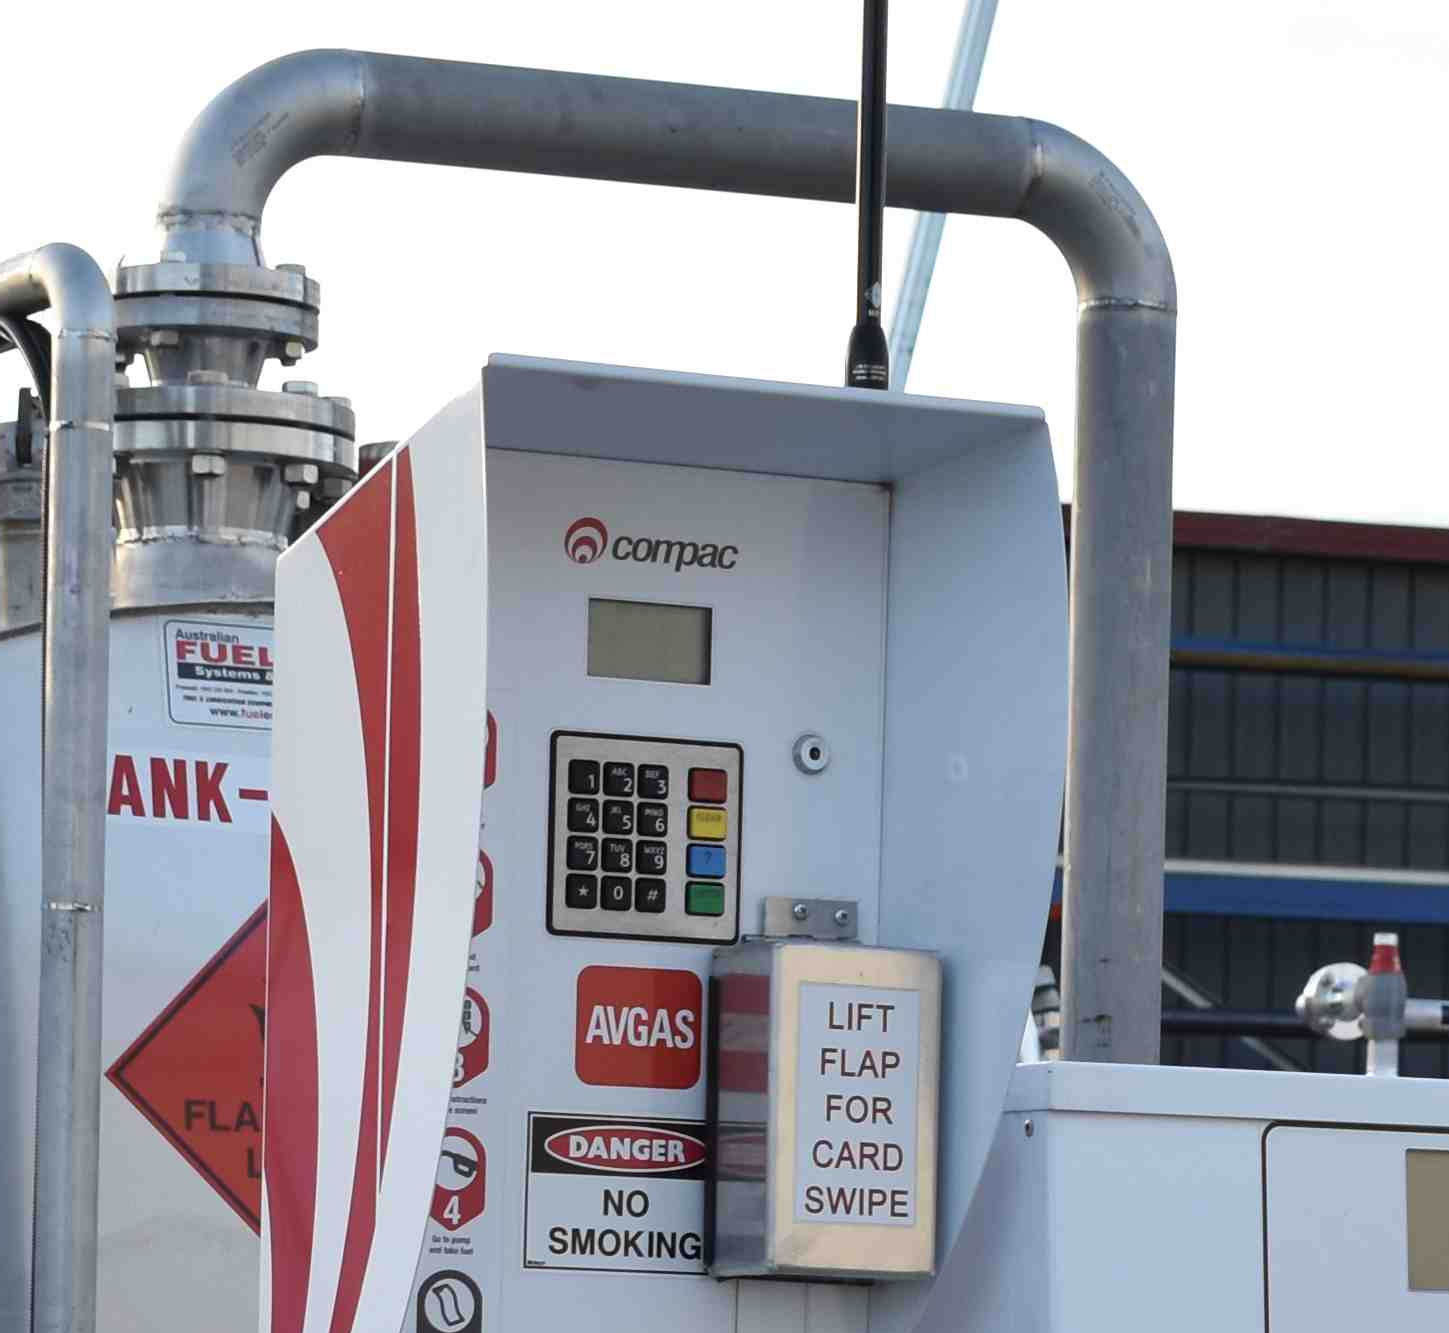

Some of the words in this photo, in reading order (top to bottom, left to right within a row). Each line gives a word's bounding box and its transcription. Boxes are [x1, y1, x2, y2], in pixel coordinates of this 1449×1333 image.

[611, 532, 738, 571] compac
[176, 628, 239, 643] Australian
[176, 640, 274, 666] FUEL
[195, 666, 261, 680] Systems
[108, 755, 268, 823] ANK-
[588, 774, 595, 789] 1
[623, 778, 633, 793] 2
[657, 780, 666, 794] 3
[586, 813, 596, 827] 4
[622, 815, 632, 830] 5
[655, 818, 665, 832] 6
[586, 851, 596, 865] 7
[620, 853, 630, 867] 8
[654, 855, 664, 869] 9
[614, 886, 623, 900] 0
[647, 890, 659, 901] #
[585, 1005, 695, 1049] AVGAS
[828, 1001, 895, 1033] LIFT
[820, 1048, 901, 1079] FLAP
[825, 1094, 893, 1124] FOR
[568, 1134, 685, 1162] DANGER
[812, 1140, 904, 1171] CARD
[443, 1195, 461, 1224] 4
[602, 1189, 650, 1217] NO
[804, 1186, 910, 1217] SWIPE
[548, 1228, 702, 1260] SMOKING
